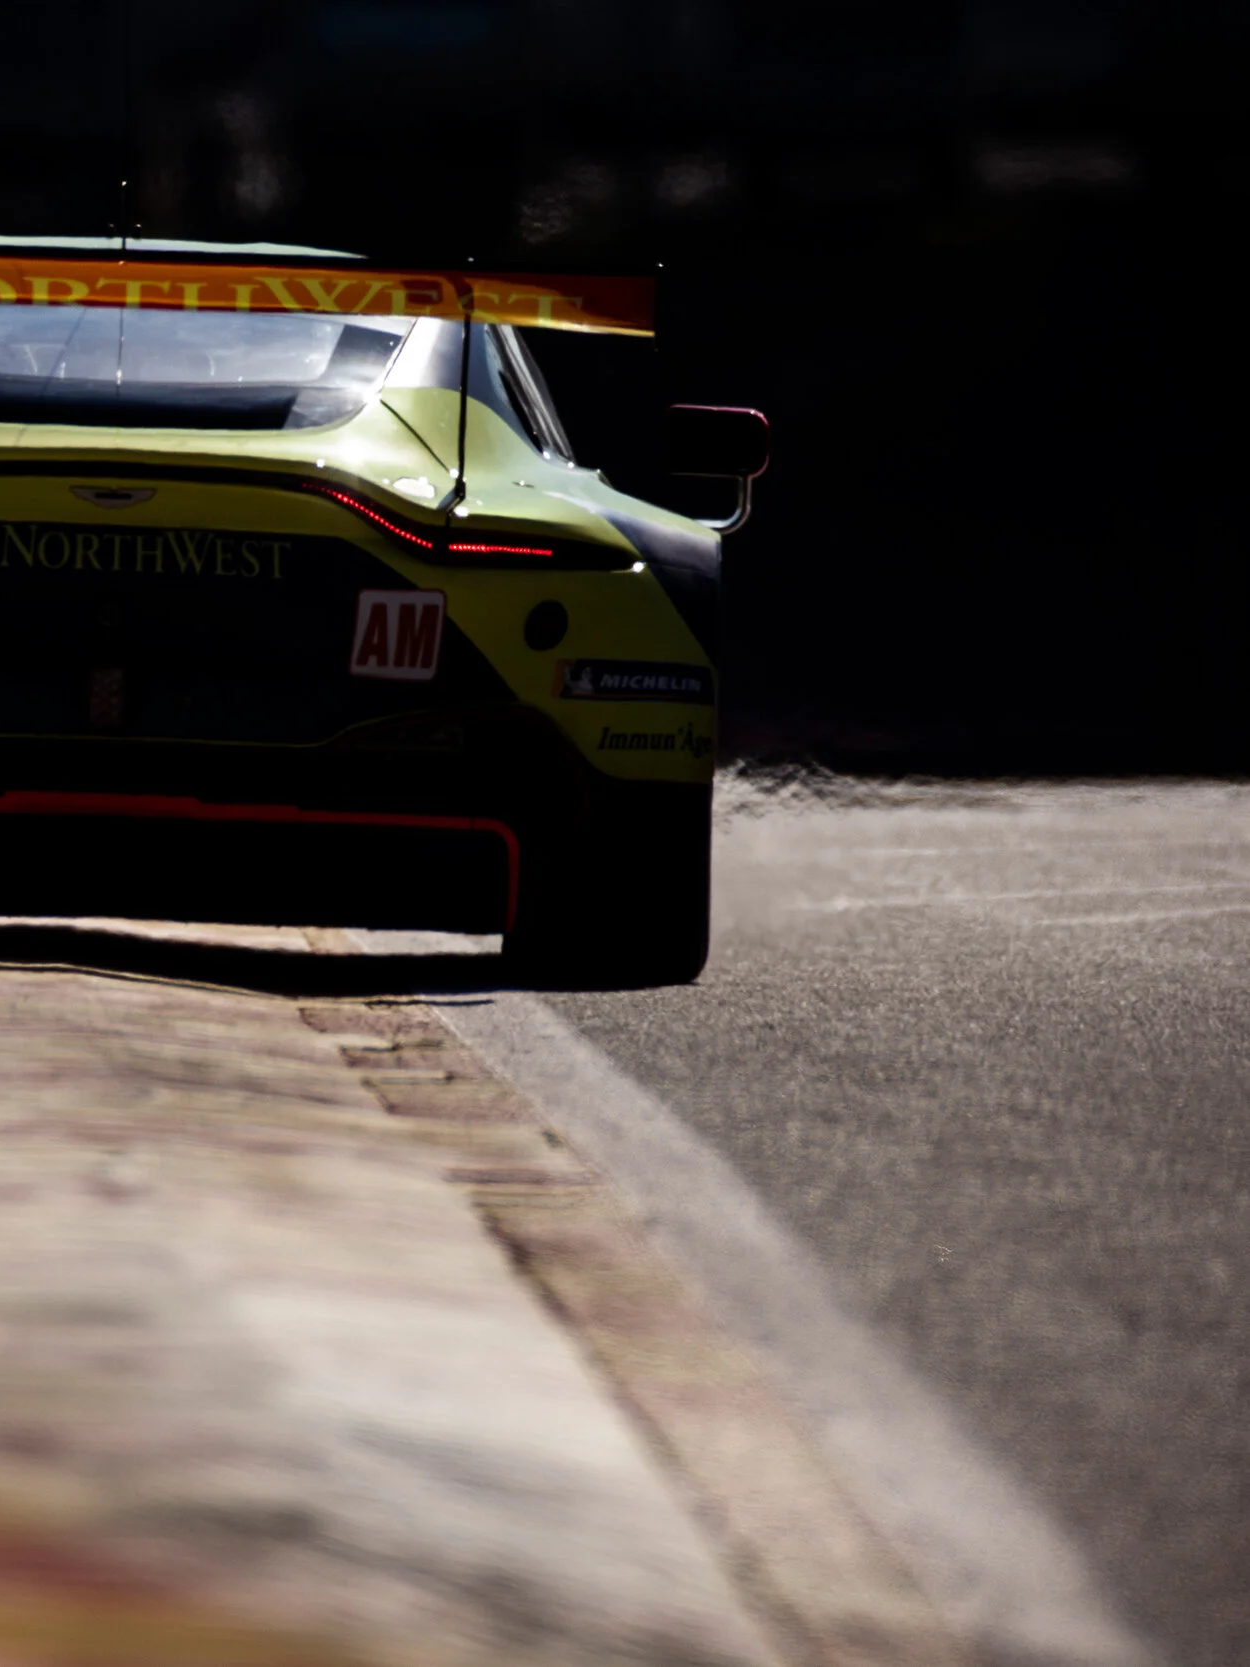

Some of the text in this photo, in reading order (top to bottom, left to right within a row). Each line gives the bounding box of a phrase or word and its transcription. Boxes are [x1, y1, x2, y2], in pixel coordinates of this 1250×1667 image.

[0, 523, 292, 581] NORTHWEST
[355, 602, 440, 669] AM
[599, 672, 703, 693] MICHELIN
